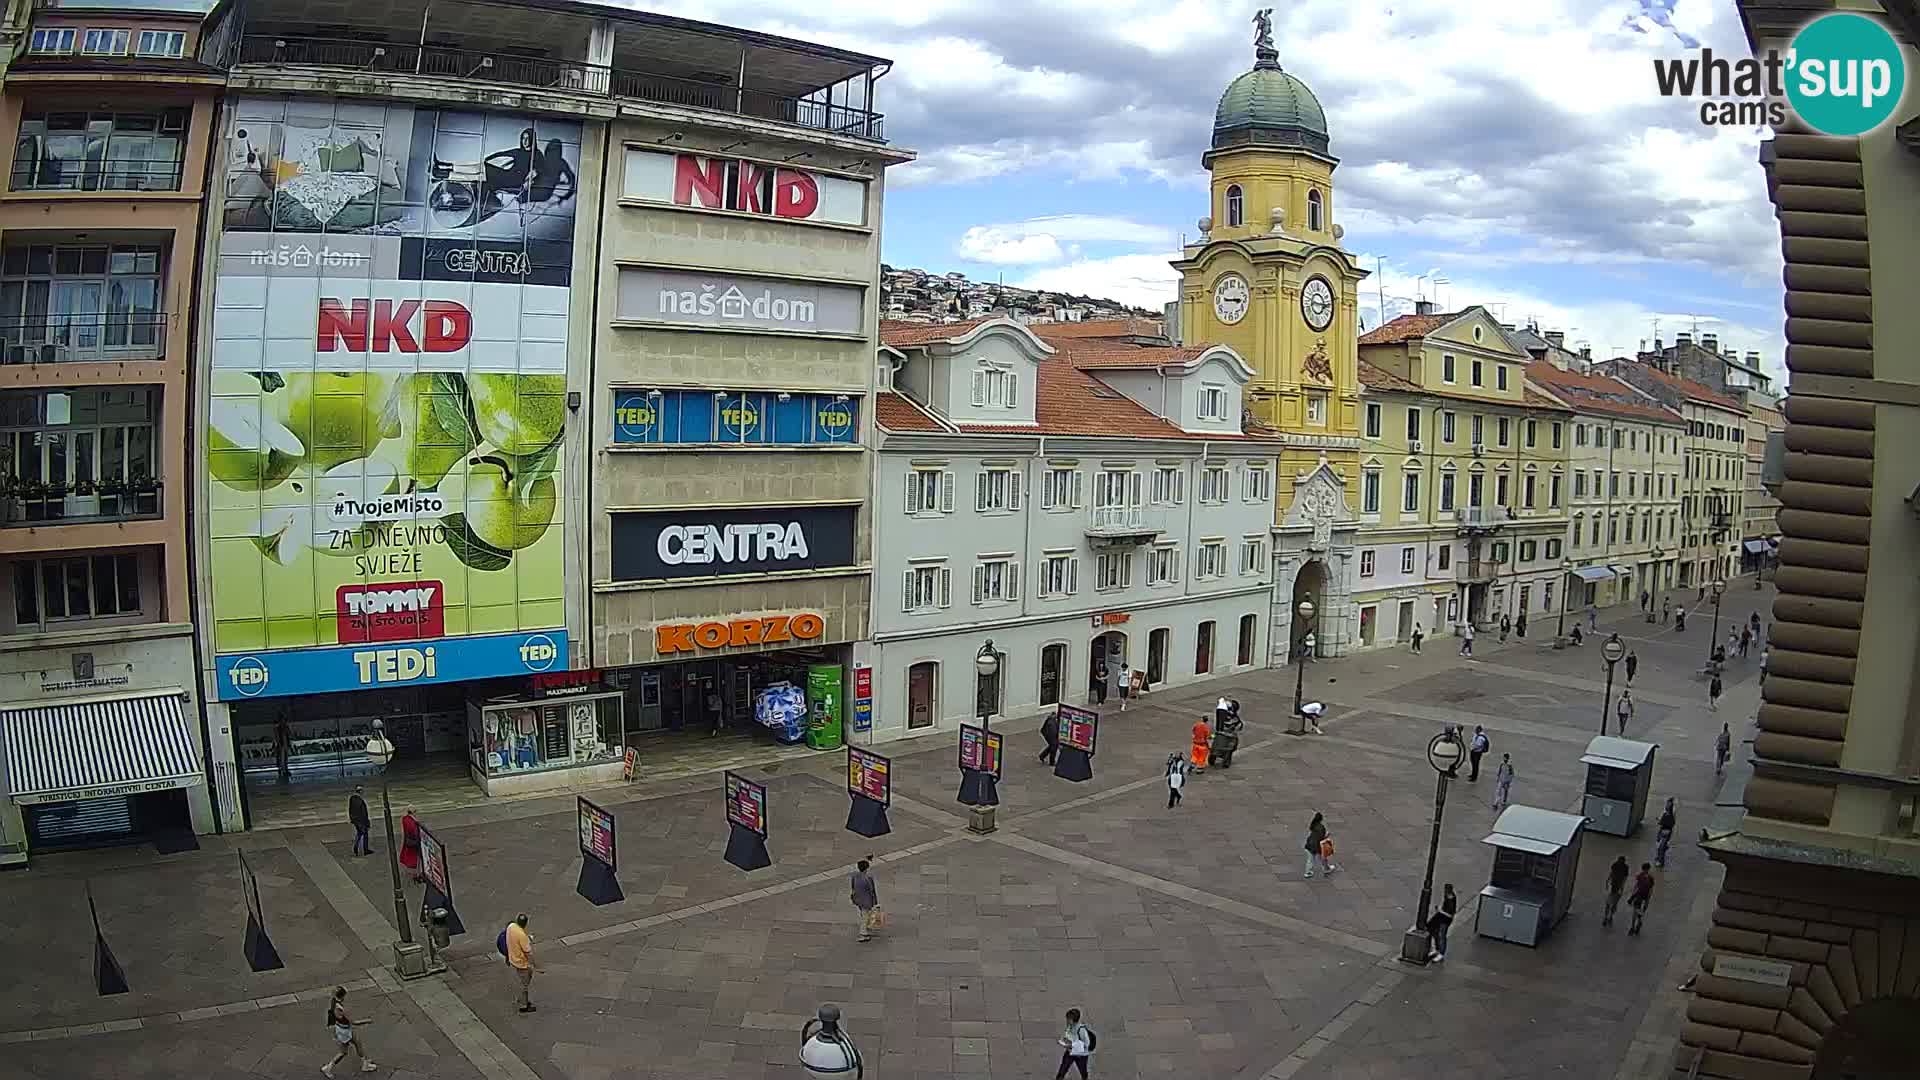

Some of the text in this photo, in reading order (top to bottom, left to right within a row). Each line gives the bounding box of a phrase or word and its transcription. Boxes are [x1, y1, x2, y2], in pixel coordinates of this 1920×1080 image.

[673, 153, 819, 219] NKD
[249, 242, 362, 268] naš dom
[443, 248, 532, 275] CENTRA
[658, 283, 815, 322] naš dom
[316, 297, 474, 354] NKD
[616, 407, 656, 426] TEDi
[721, 408, 758, 426] TEDi
[818, 410, 852, 427] TEDi
[333, 497, 443, 517] #TvojeMisto
[329, 523, 447, 550] ZA DNEVNO
[657, 521, 809, 565] CENTRA
[355, 550, 424, 576] SVJEŽE
[344, 587, 436, 616] TOMMY
[656, 613, 825, 655] KORZO
[353, 646, 437, 685] TEDi
[520, 643, 557, 662] TEDi
[229, 666, 269, 686] TEDi
